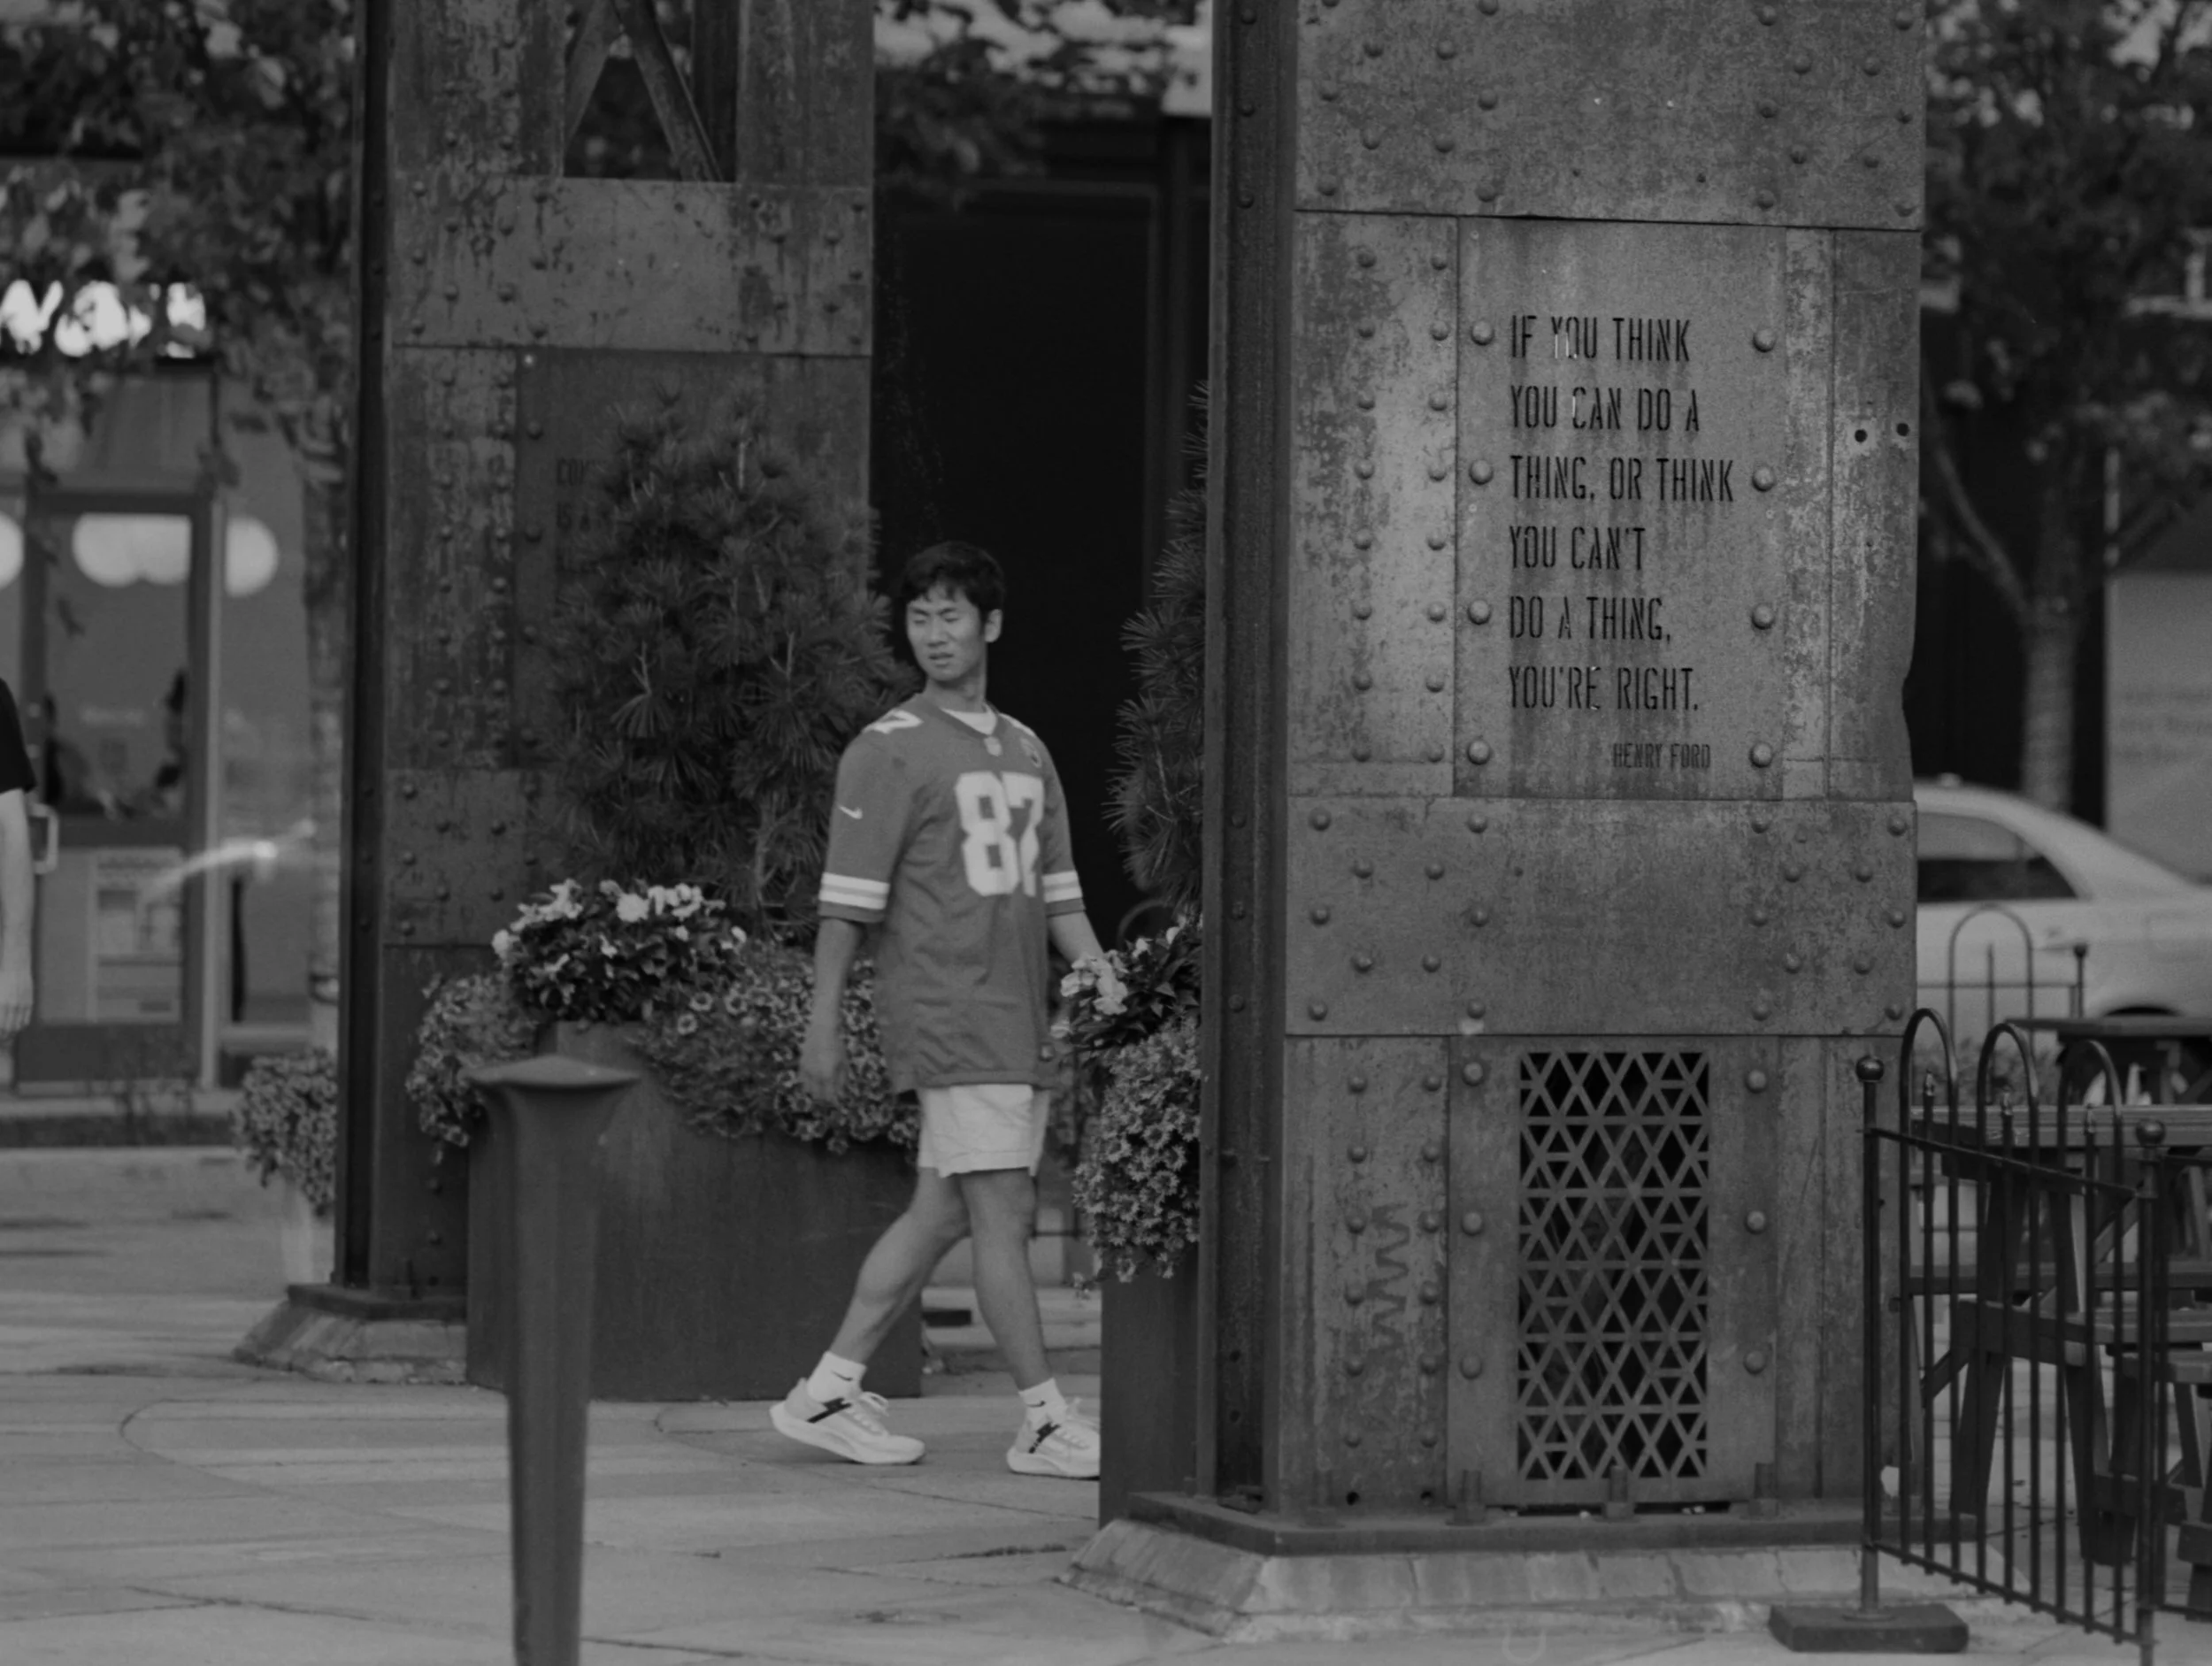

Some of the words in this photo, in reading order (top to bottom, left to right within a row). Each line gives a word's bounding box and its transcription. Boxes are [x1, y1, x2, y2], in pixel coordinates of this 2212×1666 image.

[1511, 315, 1537, 358] IF
[1552, 316, 1597, 359] YOU
[1613, 318, 1690, 362] THINK
[1511, 385, 1557, 428] YOU
[1571, 387, 1621, 430] CAN
[1638, 388, 1671, 431] DO
[1686, 388, 1700, 432] A
[1610, 457, 1641, 501] OR
[1656, 457, 1733, 502] THINK
[1509, 526, 1556, 569] YOU
[1571, 526, 1646, 570] CAN'T
[1510, 595, 1543, 639] DO
[1558, 596, 1572, 640] A
[1509, 666, 1601, 710] YOU'RE
[1612, 743, 1663, 769] HENRY
[1671, 744, 1711, 771] FORD
[955, 771, 1044, 897] 87
